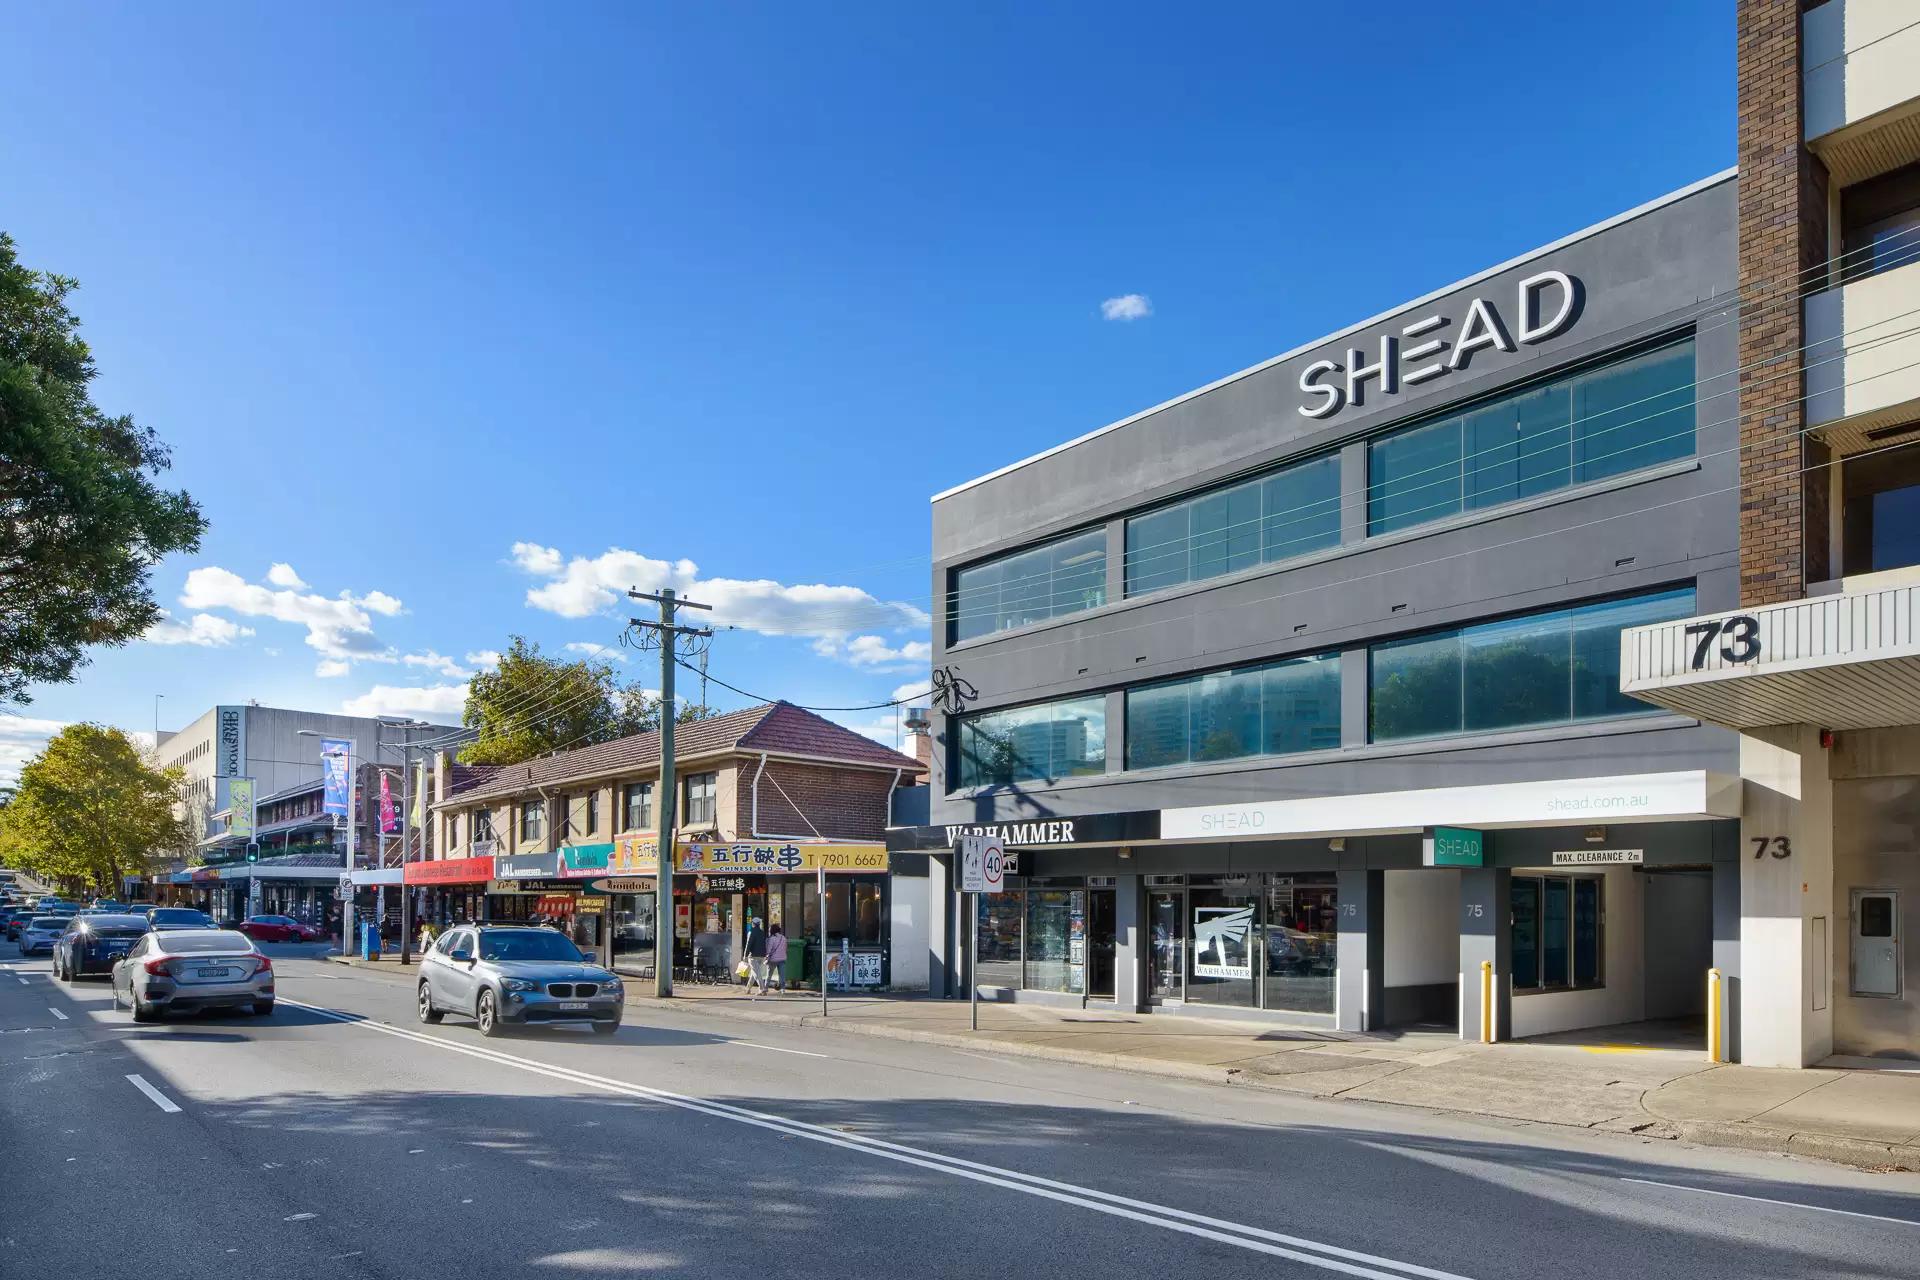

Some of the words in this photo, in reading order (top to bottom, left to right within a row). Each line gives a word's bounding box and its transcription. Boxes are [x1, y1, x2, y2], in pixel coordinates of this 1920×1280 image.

[1298, 270, 1575, 418] SHEAD
[1685, 616, 1762, 670] 73
[222, 711, 232, 744] CHASE
[229, 711, 239, 777] CHATSWOOD
[1547, 795, 1649, 812] shead.com.au
[1201, 811, 1265, 830] SHEAD
[1438, 838, 1479, 857] SHEAD
[1751, 836, 1792, 860] 73
[808, 854, 815, 866] T
[822, 853, 850, 867] 7901
[854, 853, 884, 866] 6667
[986, 856, 1001, 874] 40
[1555, 853, 1575, 863] MAX.
[1576, 851, 1623, 862] CLEARANCE
[1627, 851, 1640, 861] 2m
[501, 863, 515, 877] JAL
[525, 881, 546, 889] JAL
[1342, 904, 1357, 916] 75
[1466, 904, 1483, 917] 75
[1196, 964, 1251, 978] WARHAMMER
